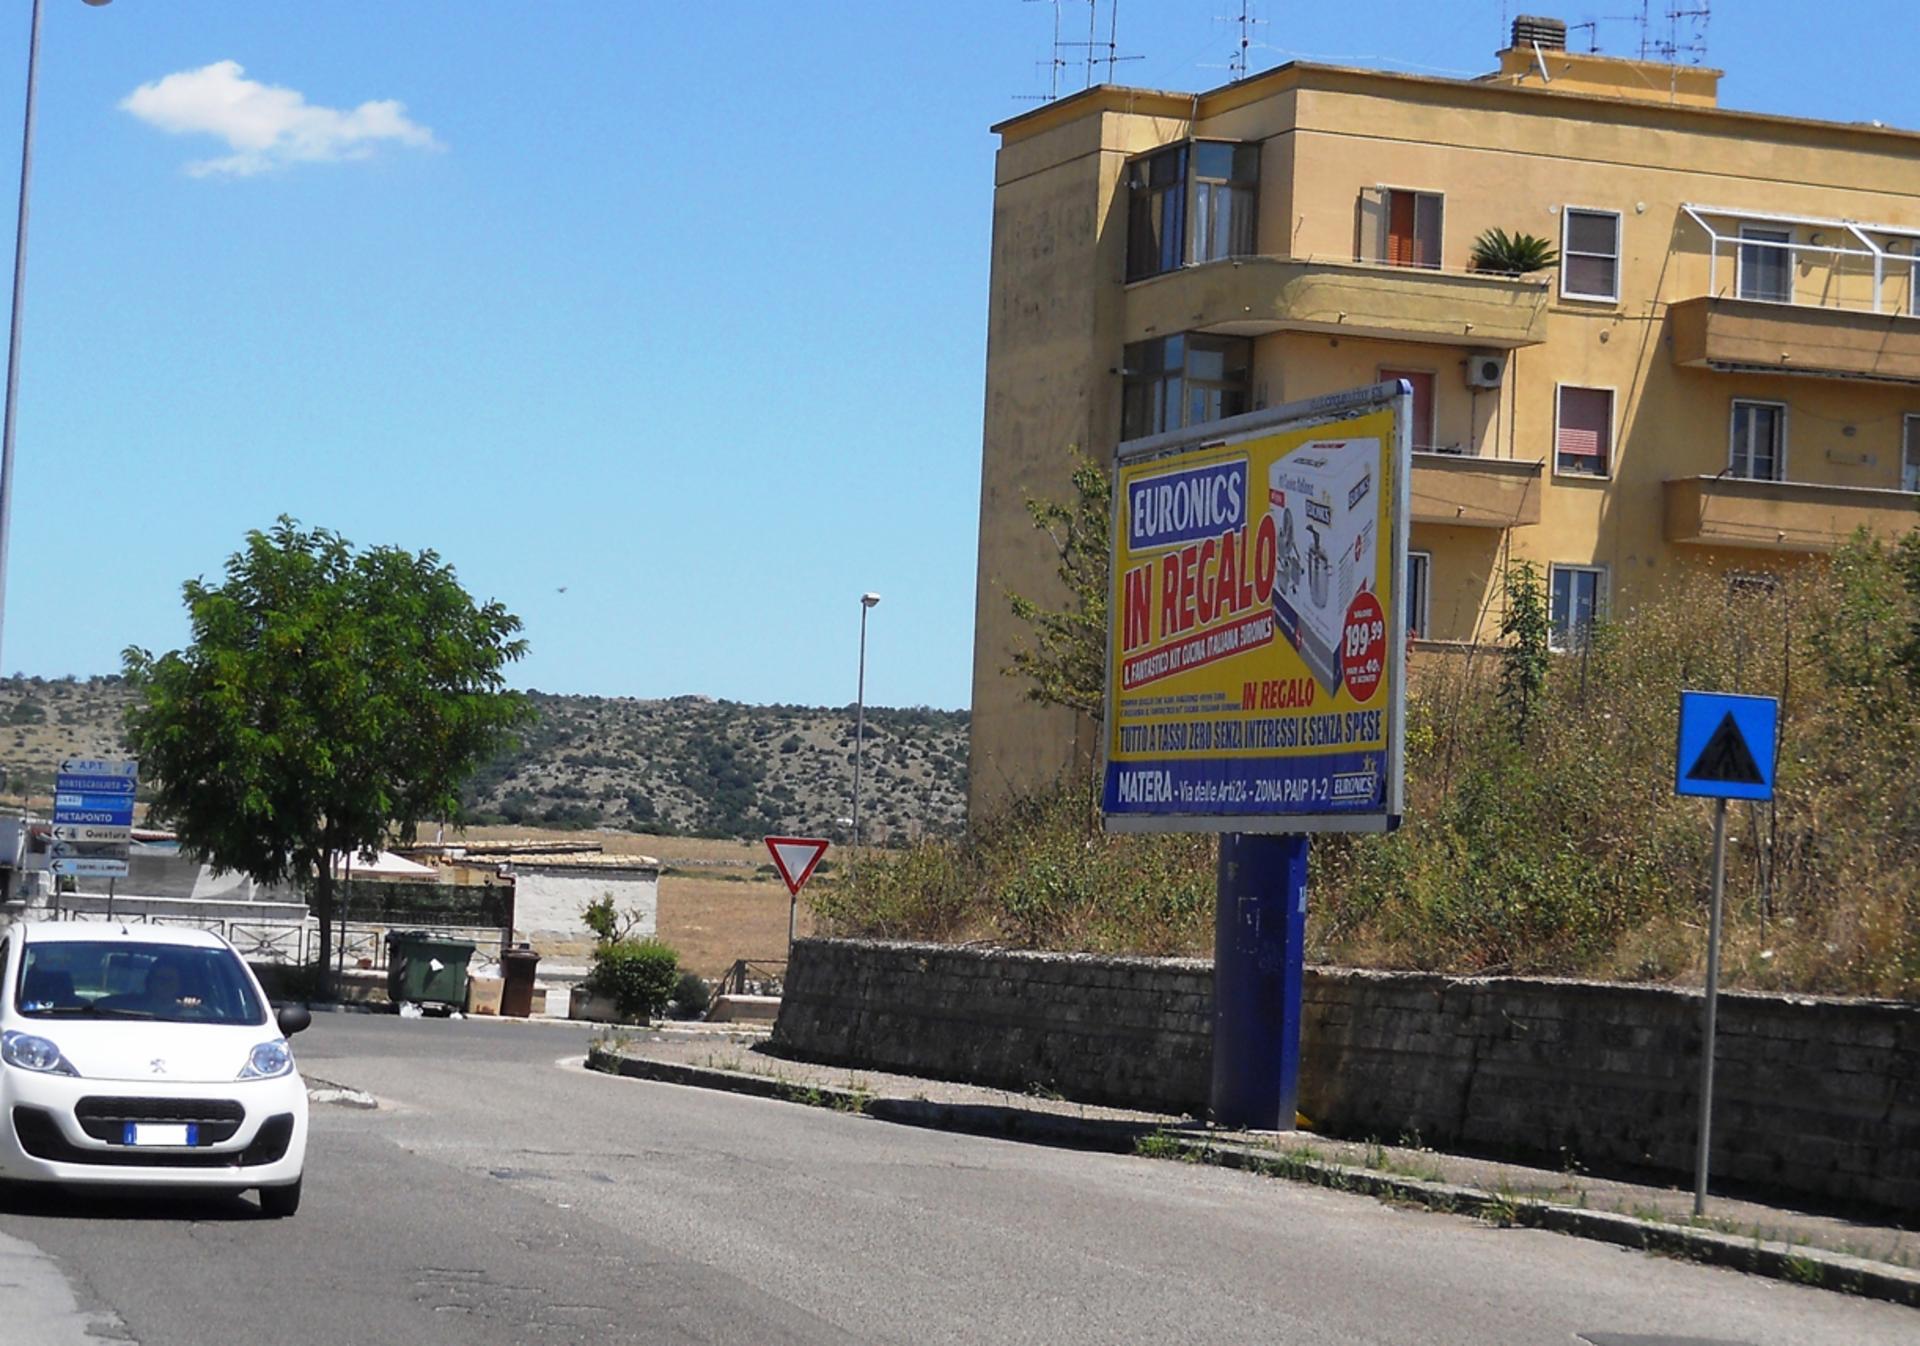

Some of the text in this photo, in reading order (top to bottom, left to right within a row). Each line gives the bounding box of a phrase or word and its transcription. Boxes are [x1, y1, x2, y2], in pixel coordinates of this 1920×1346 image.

[1134, 471, 1241, 538] EURONICS
[1123, 513, 1277, 653] IN REGALO
[1131, 651, 1169, 682] FANTASTICO
[1169, 646, 1182, 669] KIT
[1182, 638, 1206, 665] CUCINA
[1207, 626, 1239, 656] ITALIANA
[1240, 615, 1273, 647] EURONICS
[1243, 682, 1256, 710] IN
[1260, 677, 1315, 710] REGALO
[1120, 722, 1149, 753] TUTTO
[1149, 724, 1156, 751] A
[1157, 721, 1188, 751] TASSO
[1189, 721, 1212, 750] ZERO
[1213, 719, 1242, 749] SENZA
[1244, 717, 1299, 748] INTERESSI
[1309, 712, 1343, 745] SENZA
[1345, 709, 1382, 743] SPESE
[1118, 770, 1173, 802] MATERA
[1180, 780, 1194, 801] Via
[1194, 780, 1217, 801] delle
[1254, 779, 1284, 802] ZONA
[1284, 779, 1309, 801] PAIP
[1334, 776, 1373, 795] EURONICS
[56, 813, 112, 823] METAPONTO
[86, 829, 126, 839] Questura
